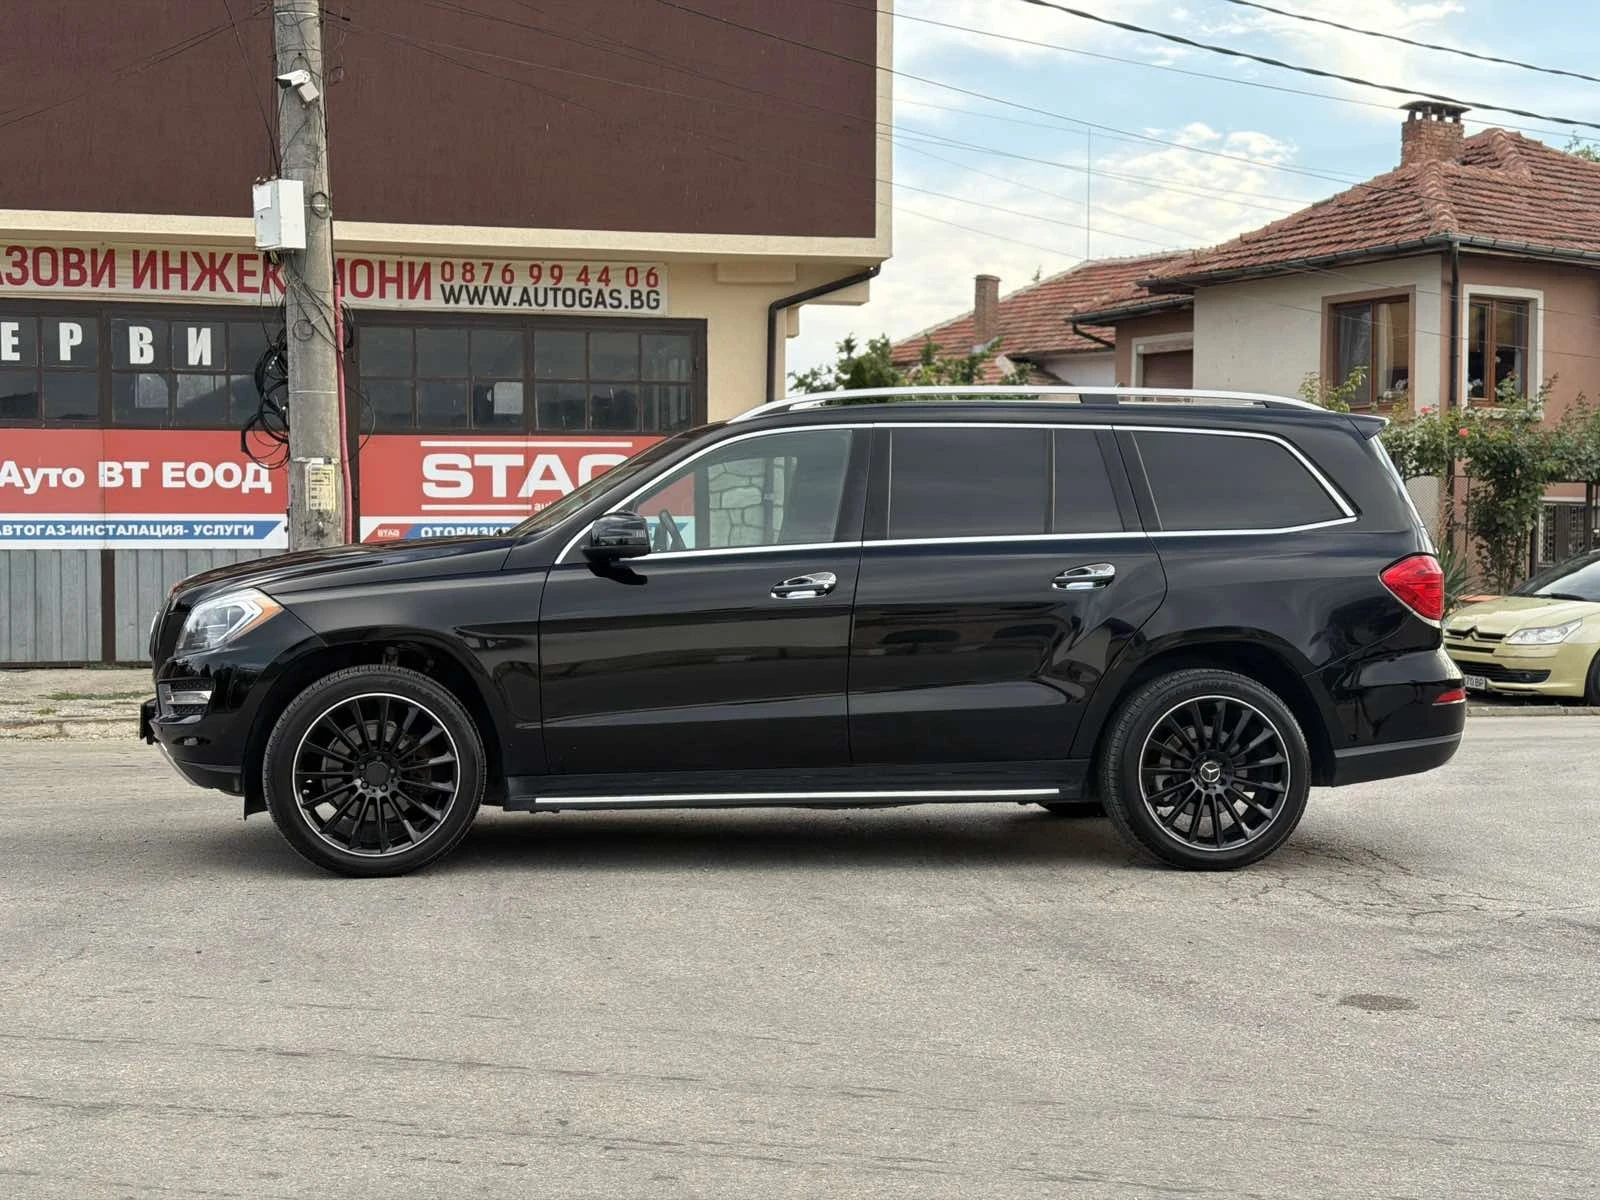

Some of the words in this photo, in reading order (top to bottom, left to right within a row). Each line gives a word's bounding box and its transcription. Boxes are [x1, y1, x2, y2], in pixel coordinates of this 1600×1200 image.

[0, 245, 116, 289] ЗОВИ
[440, 261, 515, 285] 0876
[528, 263, 564, 286] 99
[576, 265, 611, 287] 44
[625, 266, 659, 288] 06
[440, 284, 661, 310] WWW.AUTOGAS.BG
[0, 461, 86, 495] Ауто
[98, 461, 149, 489] ВТ
[161, 461, 272, 494] ЕООД
[0, 524, 189, 537] ВТОГАЗ-ИНСТАЛАЦИЯ-
[193, 524, 255, 536] УСЛУГИ
